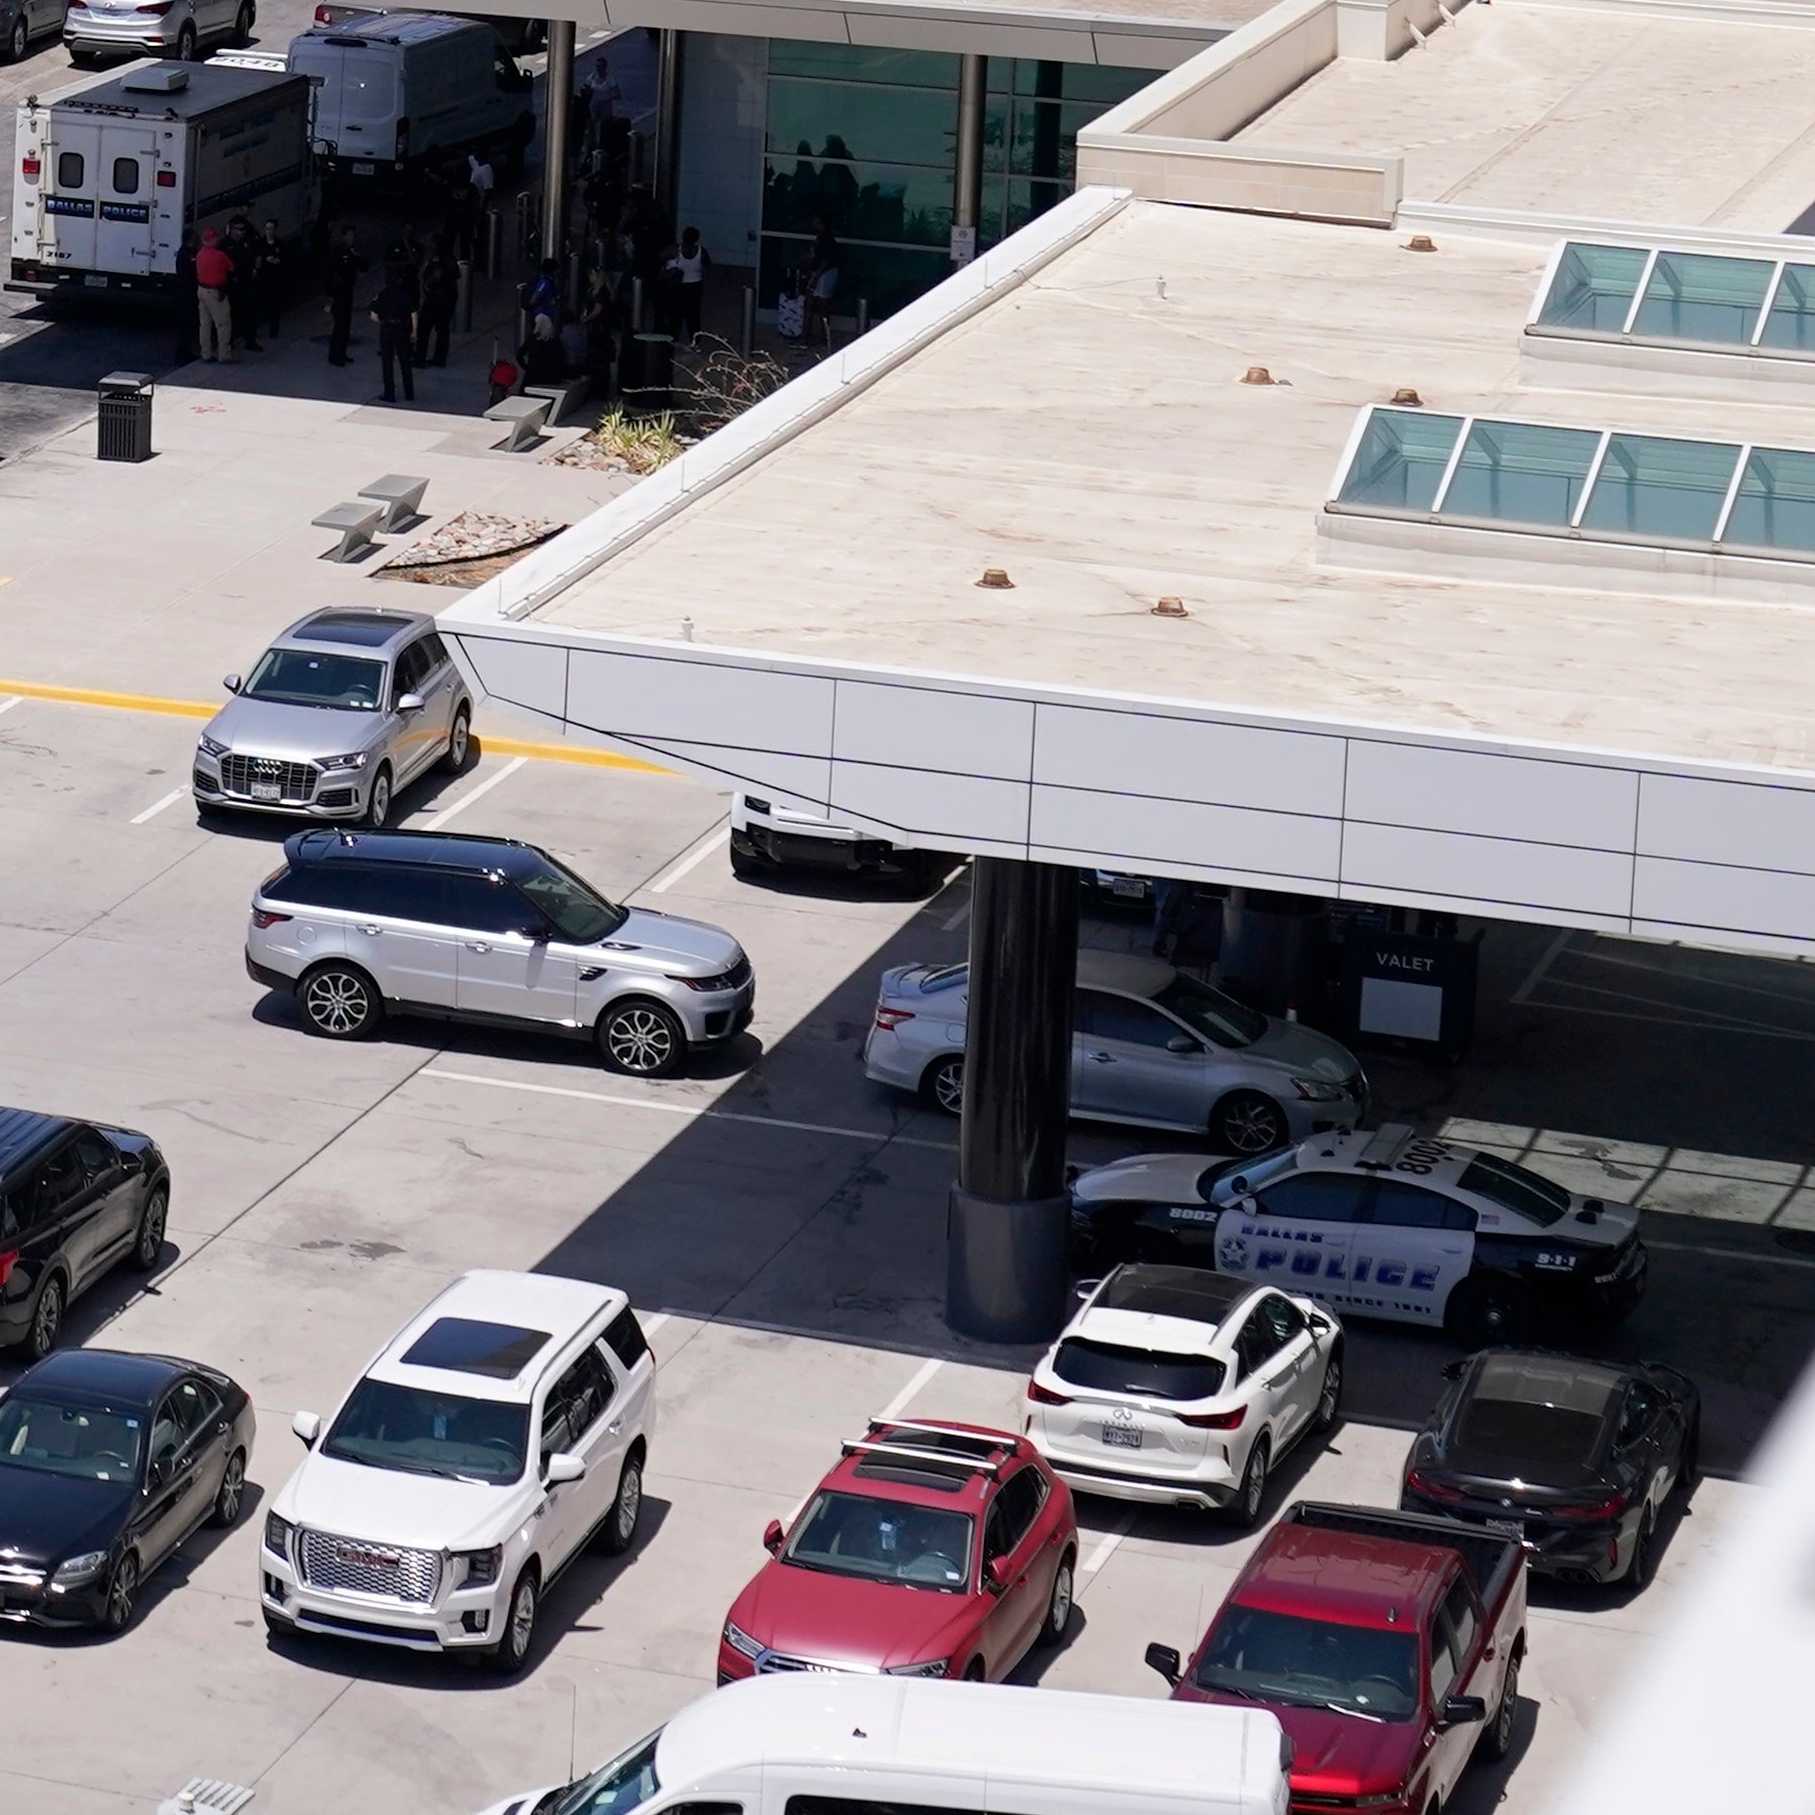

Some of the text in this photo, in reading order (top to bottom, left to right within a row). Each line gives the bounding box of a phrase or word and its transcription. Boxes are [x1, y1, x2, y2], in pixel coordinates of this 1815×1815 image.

[47, 198, 148, 219] DALLAS POLICE
[1376, 951, 1434, 972] VALET
[1170, 1207, 1218, 1223] 8002
[1241, 1225, 1325, 1244] DALLAS
[1254, 1248, 1441, 1292] POLICE
[337, 1547, 400, 1570] GMC
